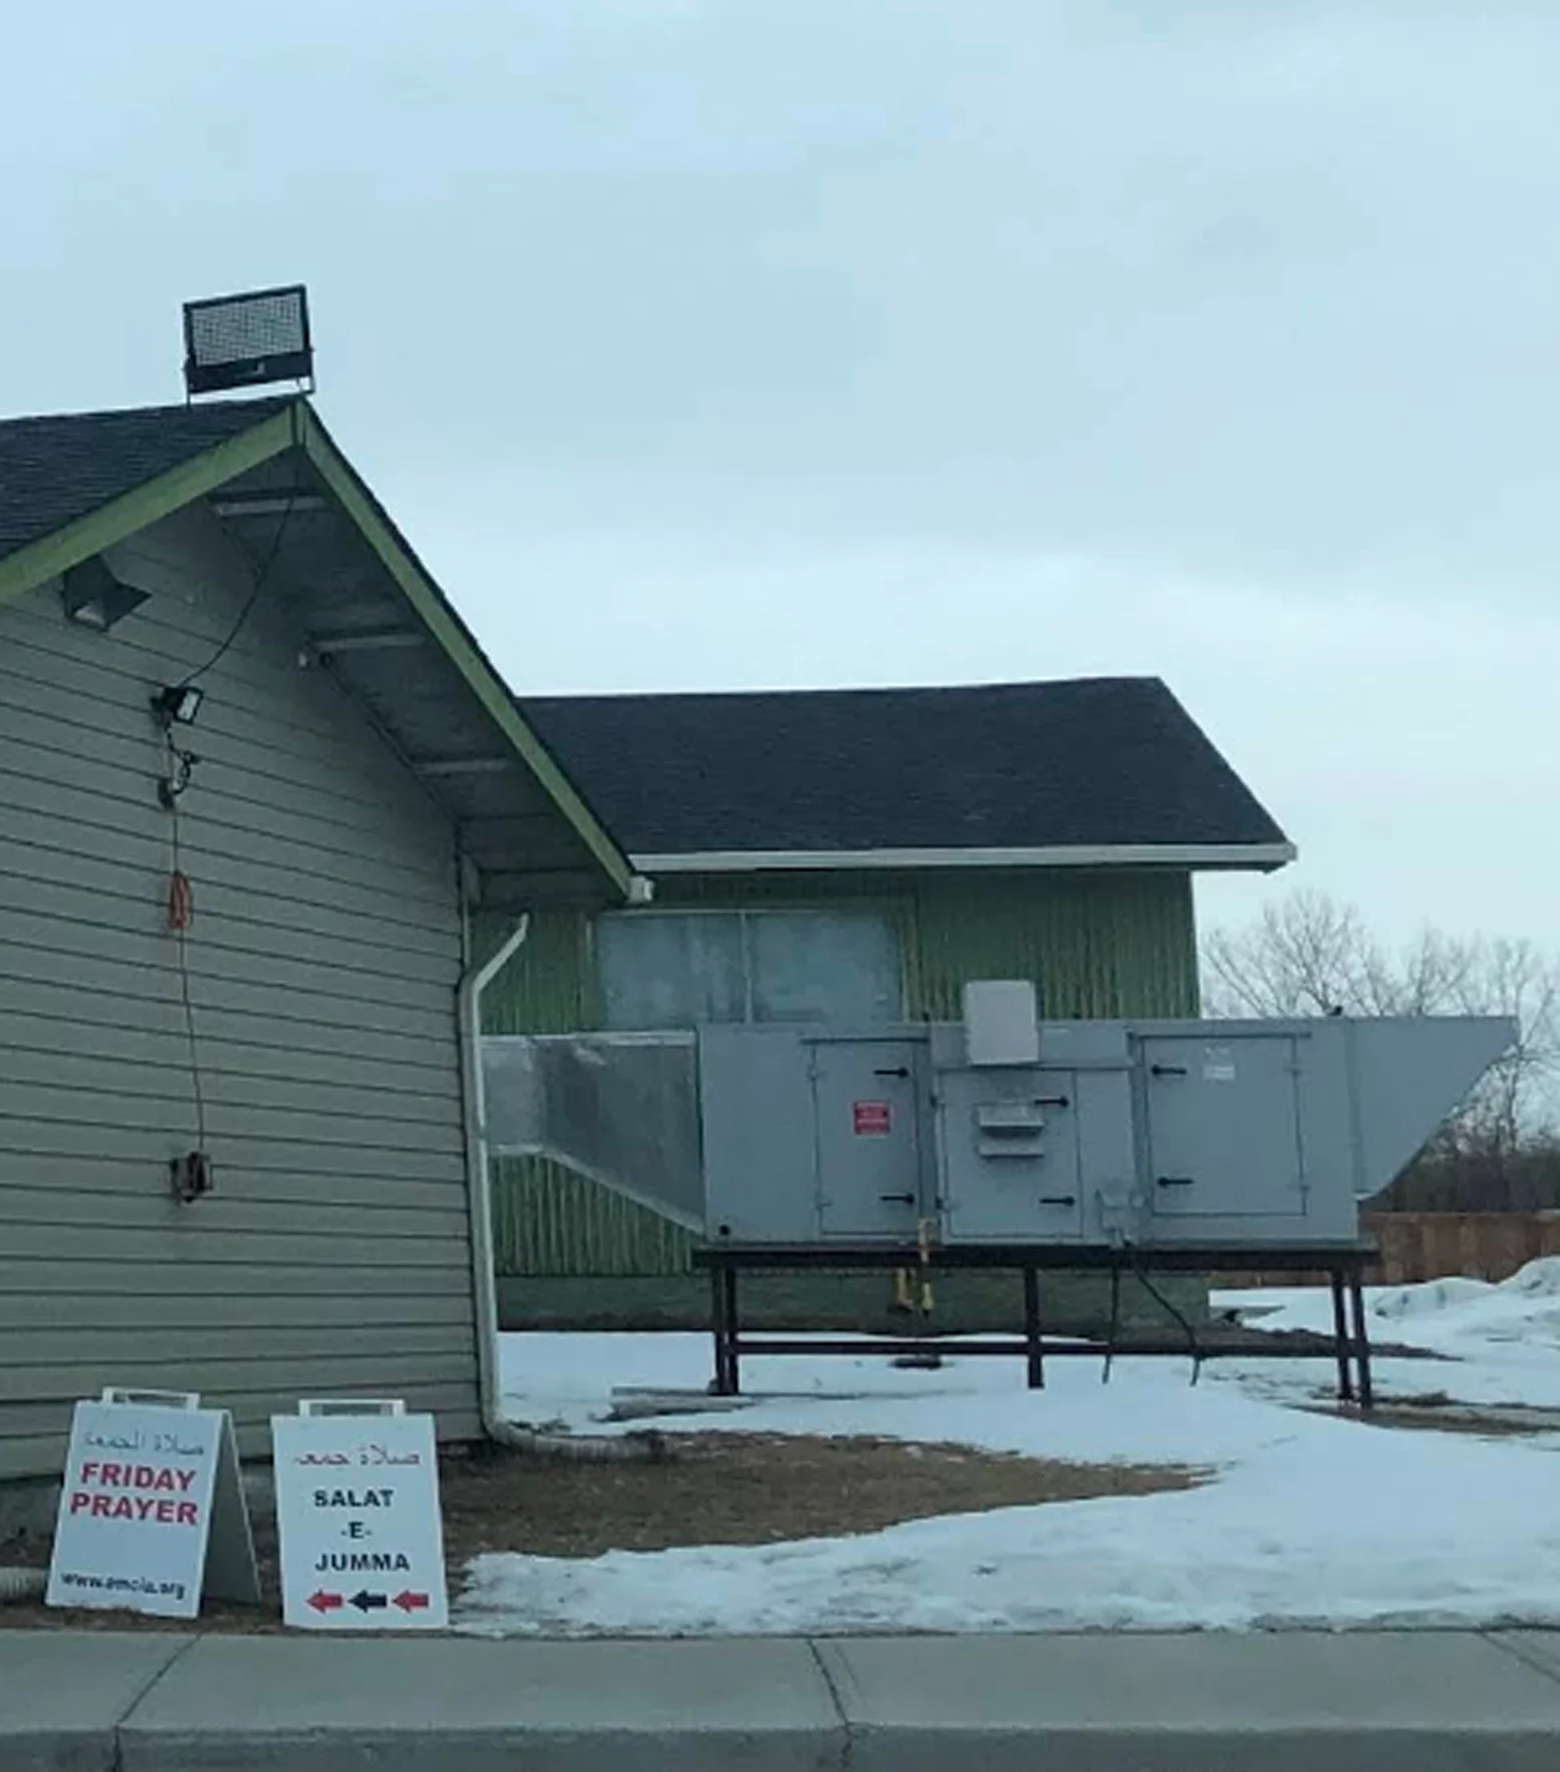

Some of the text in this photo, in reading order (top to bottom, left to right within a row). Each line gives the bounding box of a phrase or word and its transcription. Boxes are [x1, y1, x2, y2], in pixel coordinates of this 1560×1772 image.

[81, 1462, 197, 1493] FRIDAY
[70, 1492, 198, 1526] PRAYER
[313, 1489, 394, 1508] SALAT
[315, 1553, 411, 1572] JUMMA
[61, 1572, 186, 1601] www.amcia.org
